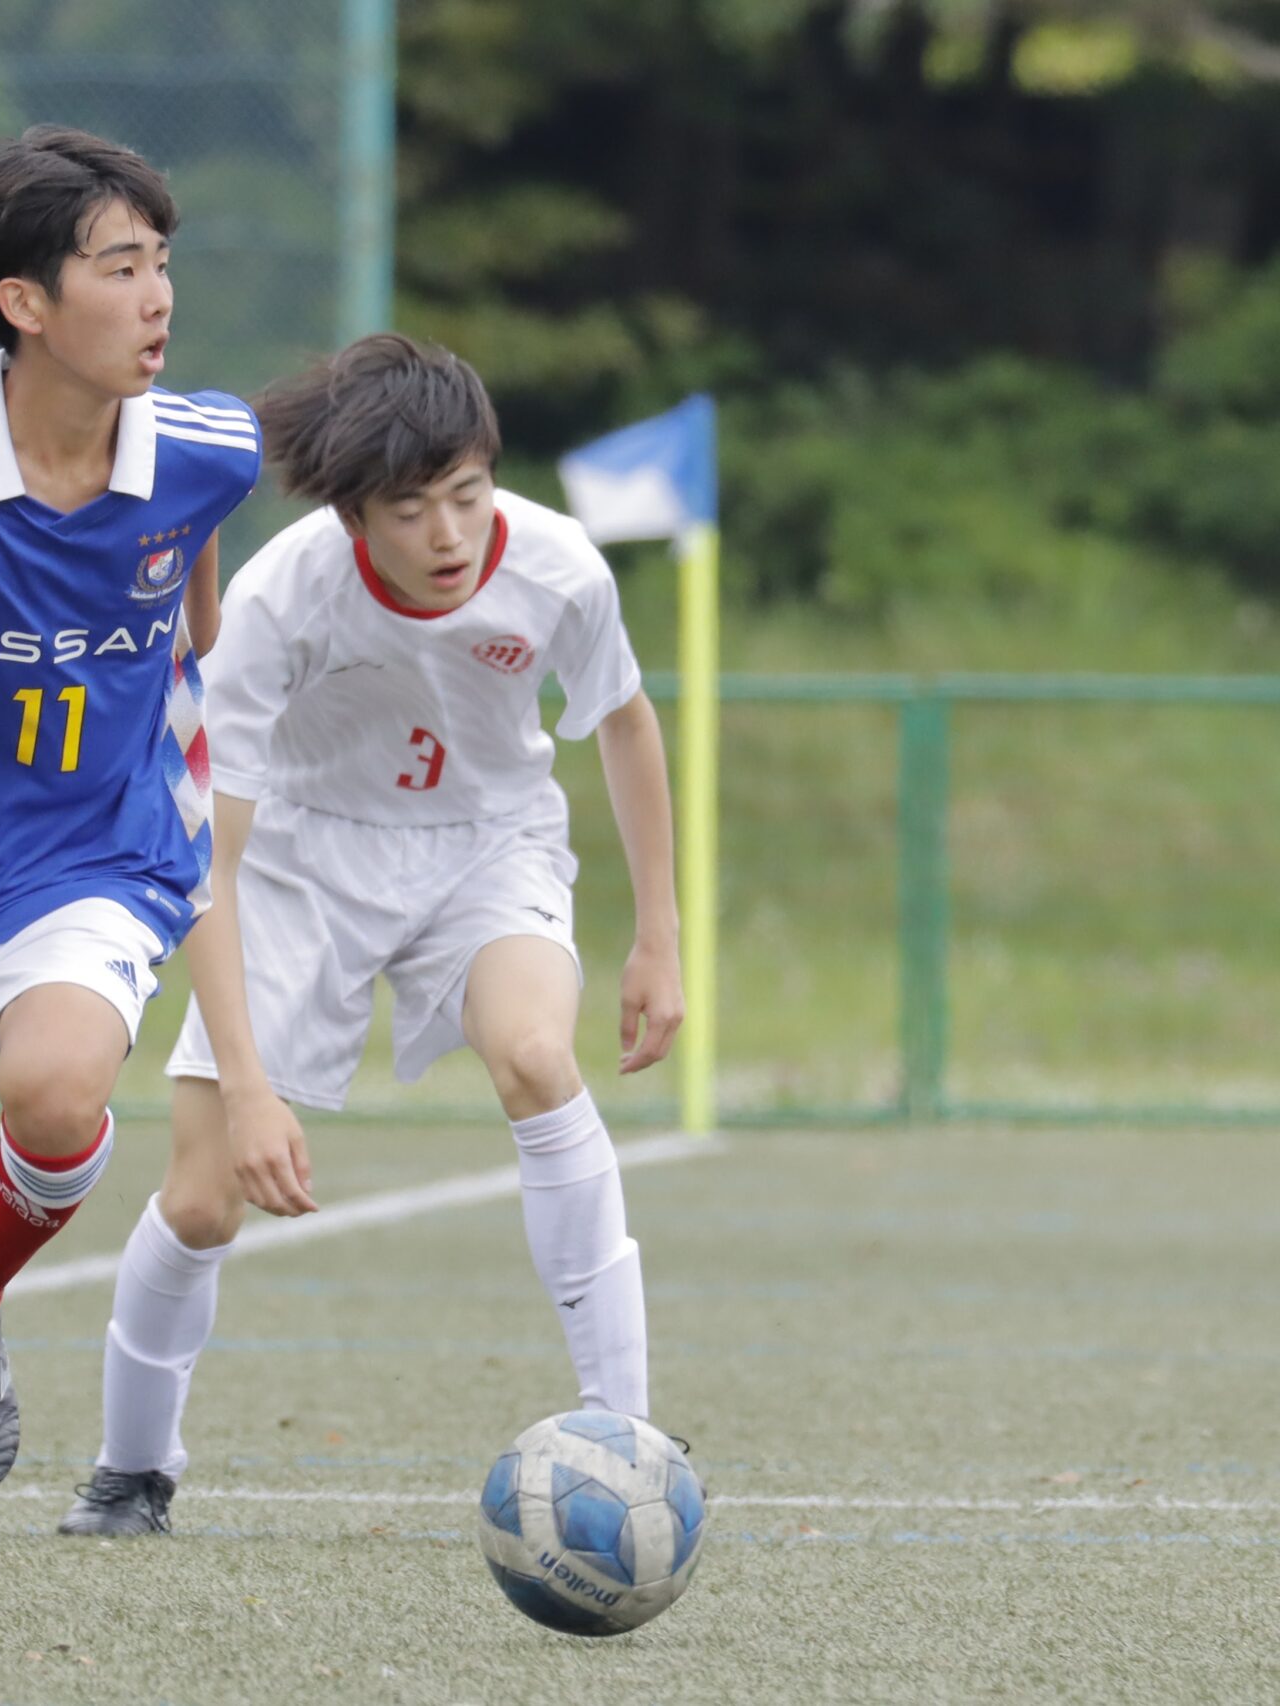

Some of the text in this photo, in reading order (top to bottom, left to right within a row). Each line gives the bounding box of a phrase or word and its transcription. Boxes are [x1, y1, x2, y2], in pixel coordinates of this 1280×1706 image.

[13, 685, 86, 772] 11
[396, 726, 446, 791] 3
[540, 1551, 622, 1605] molten
